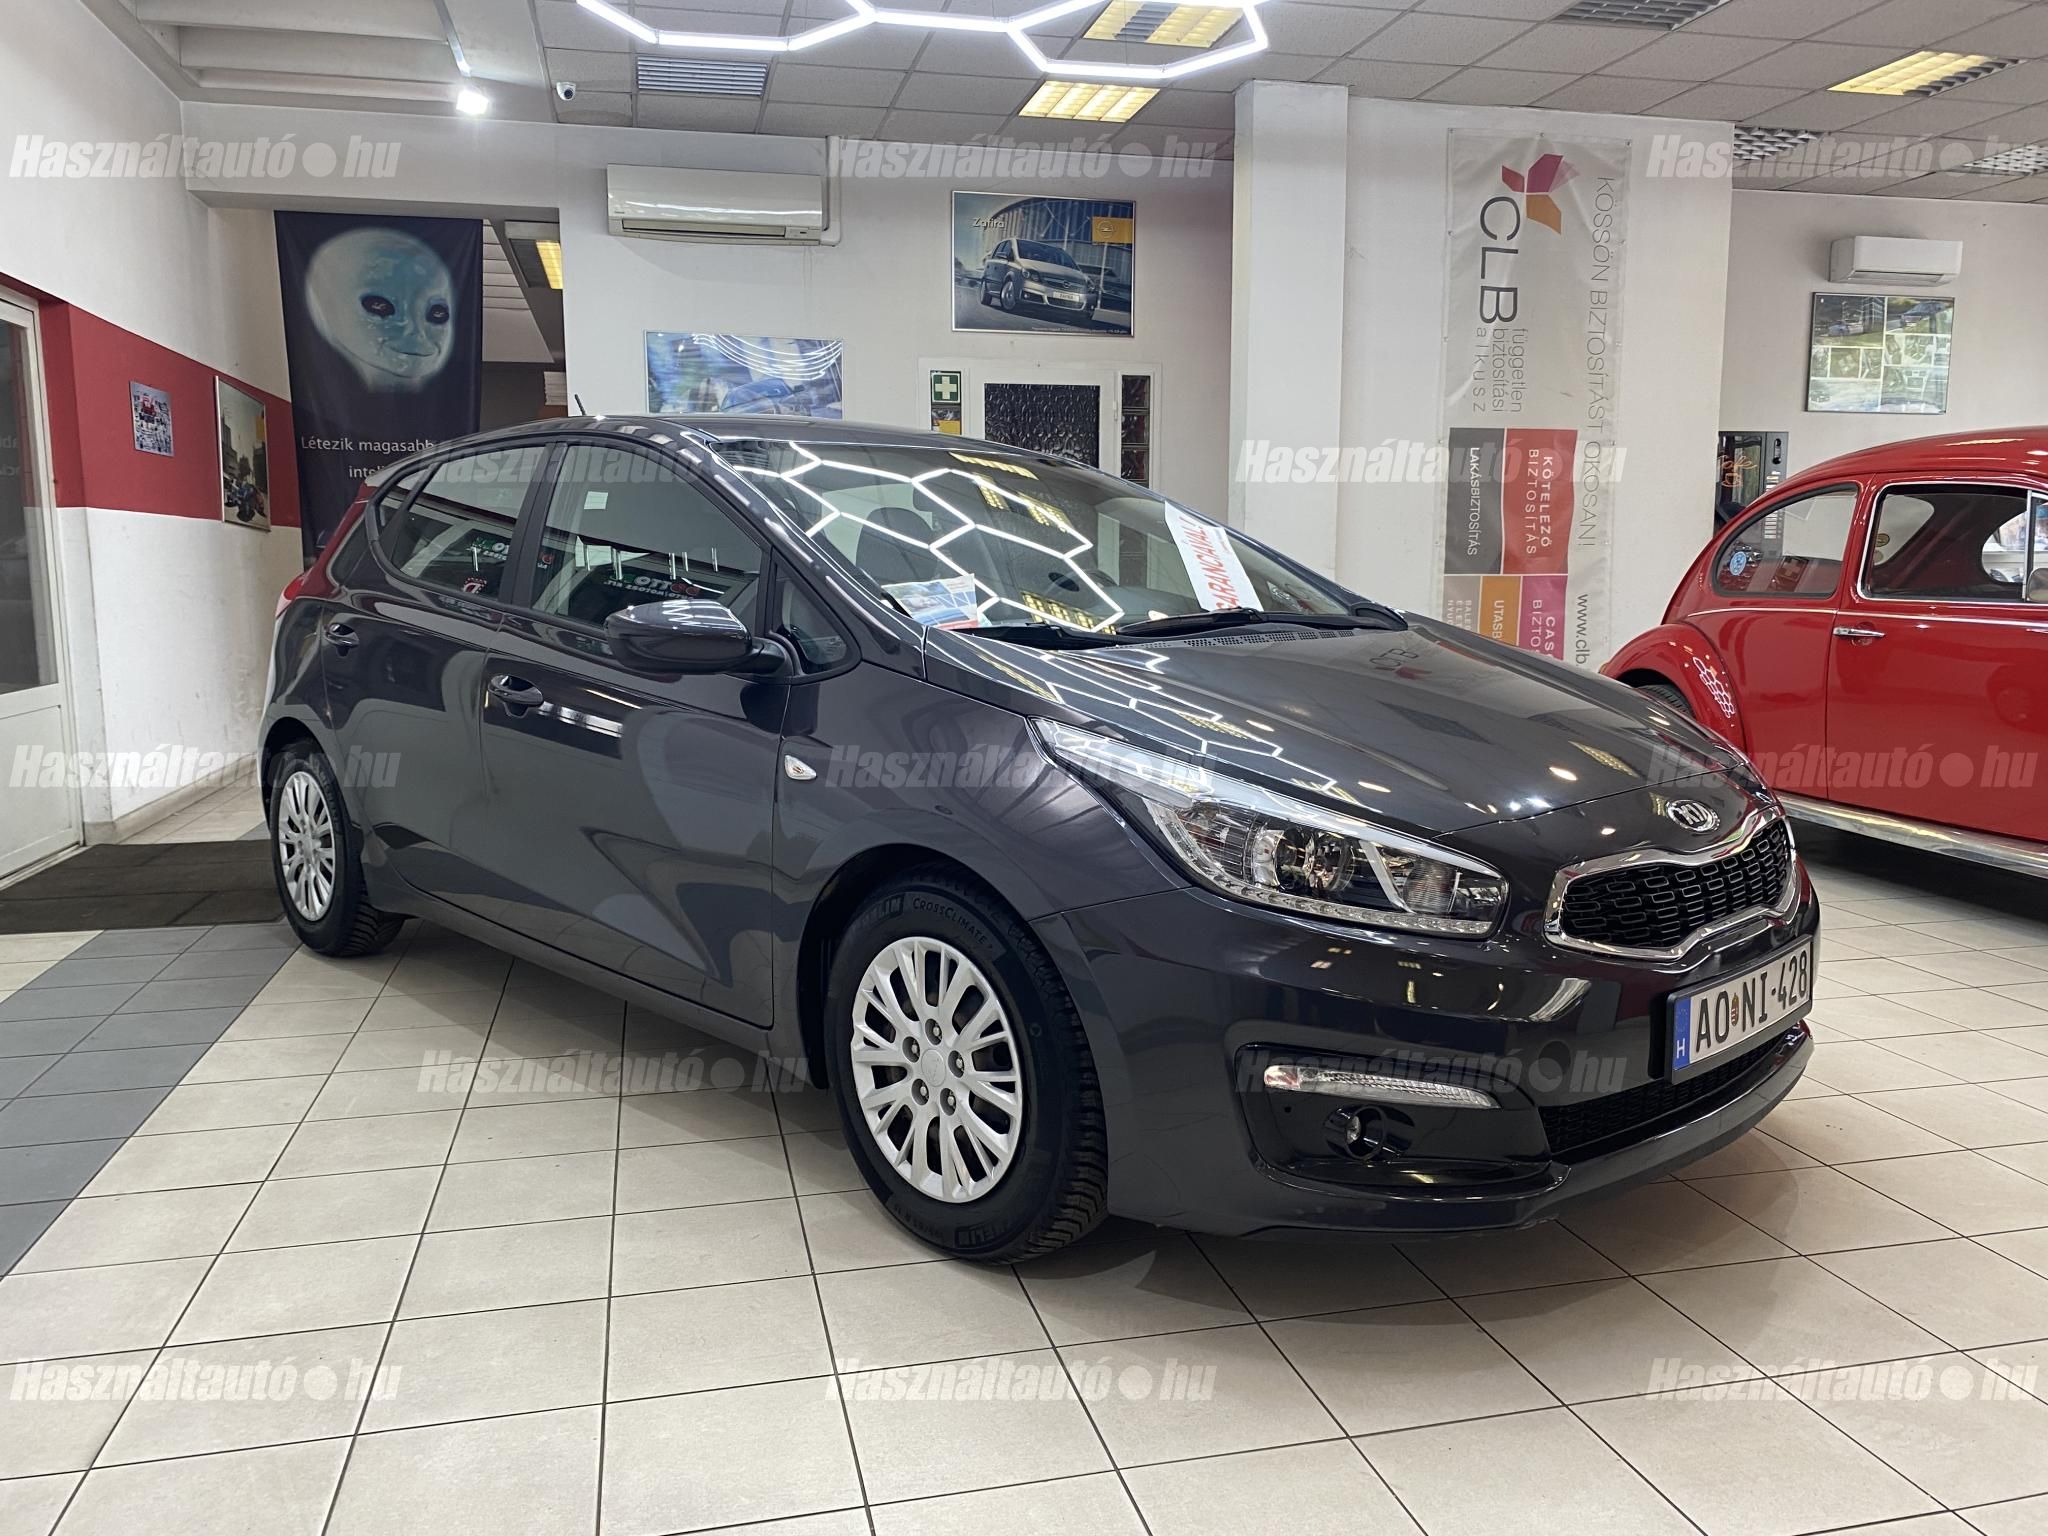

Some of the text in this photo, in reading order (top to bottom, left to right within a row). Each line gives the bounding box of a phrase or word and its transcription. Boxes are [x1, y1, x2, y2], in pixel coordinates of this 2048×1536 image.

[972, 217, 1006, 230] Zafira
[1591, 177, 1618, 281] KÖSSÖN
[1480, 196, 1520, 323] CLB
[301, 435, 354, 451] Létezik
